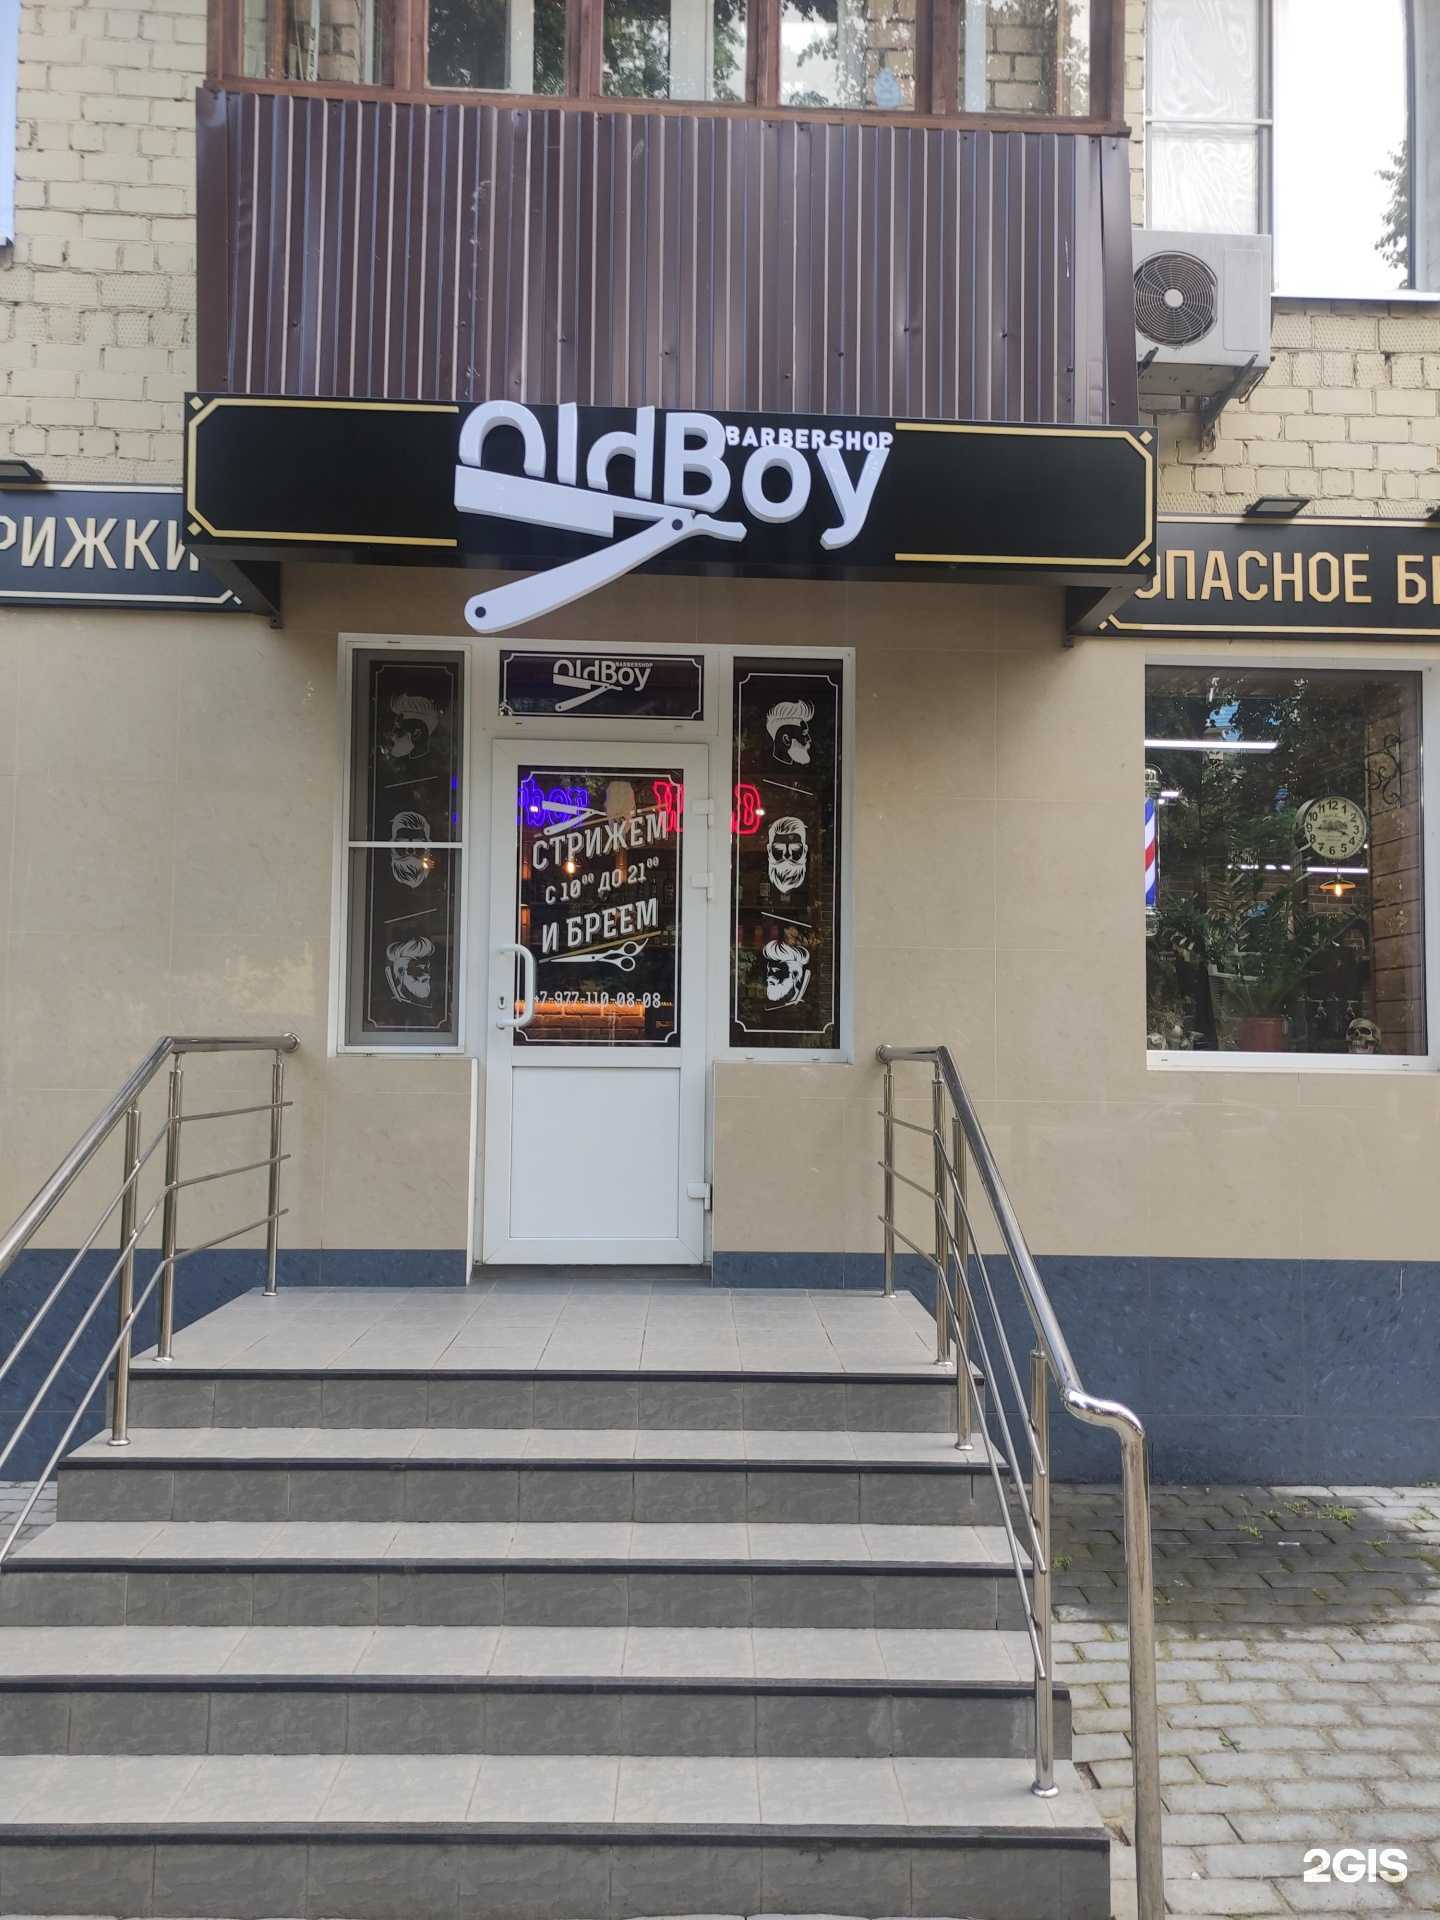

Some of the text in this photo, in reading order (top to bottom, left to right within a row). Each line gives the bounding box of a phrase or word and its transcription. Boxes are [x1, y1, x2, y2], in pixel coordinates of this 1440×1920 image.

[725, 425, 894, 452] BARBERSHOP
[458, 400, 890, 550] OldBoy
[553, 659, 651, 692] OldBoy
[532, 811, 668, 870] СТРИЖЕМ
[598, 868, 623, 894] ДО
[542, 898, 659, 953] И БРЕЕМ
